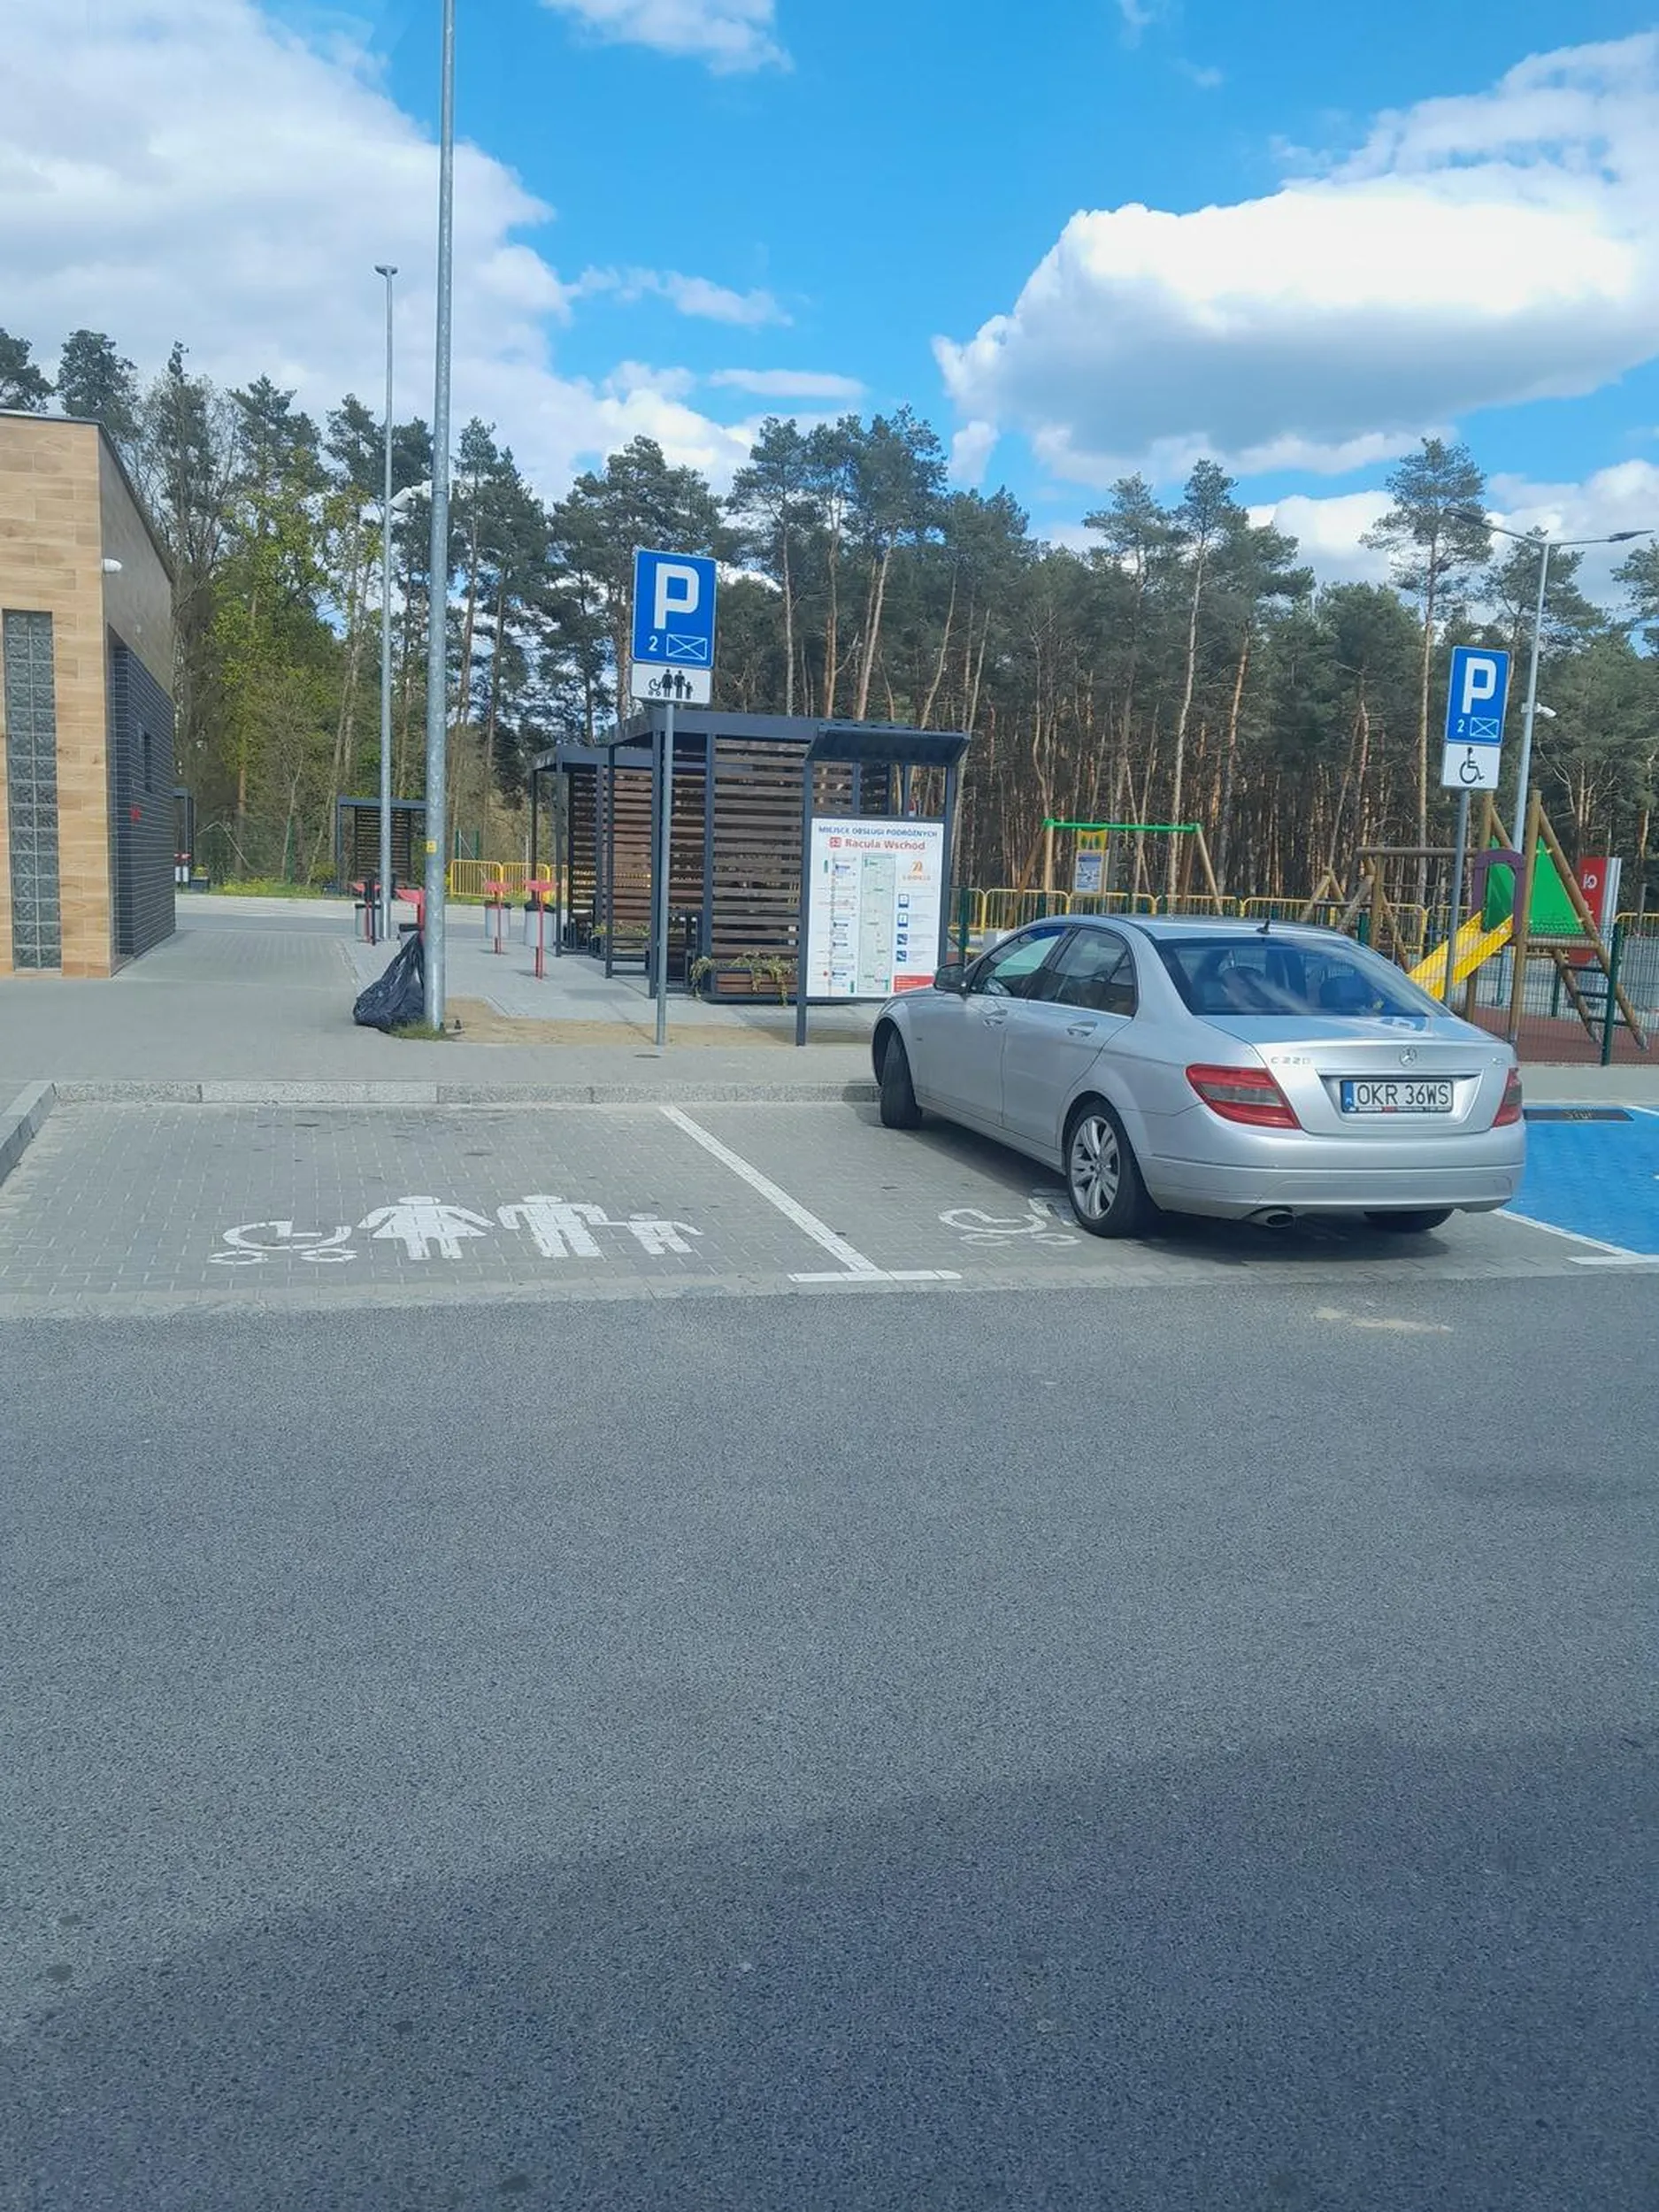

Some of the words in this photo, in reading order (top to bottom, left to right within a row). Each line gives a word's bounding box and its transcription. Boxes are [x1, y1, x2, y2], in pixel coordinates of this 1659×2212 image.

[654, 562, 700, 629] P
[649, 635, 658, 652] 2
[1462, 657, 1497, 714] P
[1456, 718, 1465, 733] 2
[845, 838, 881, 849] Racula
[1357, 1084, 1398, 1105] OKR
[1405, 1085, 1448, 1105] 36WS
